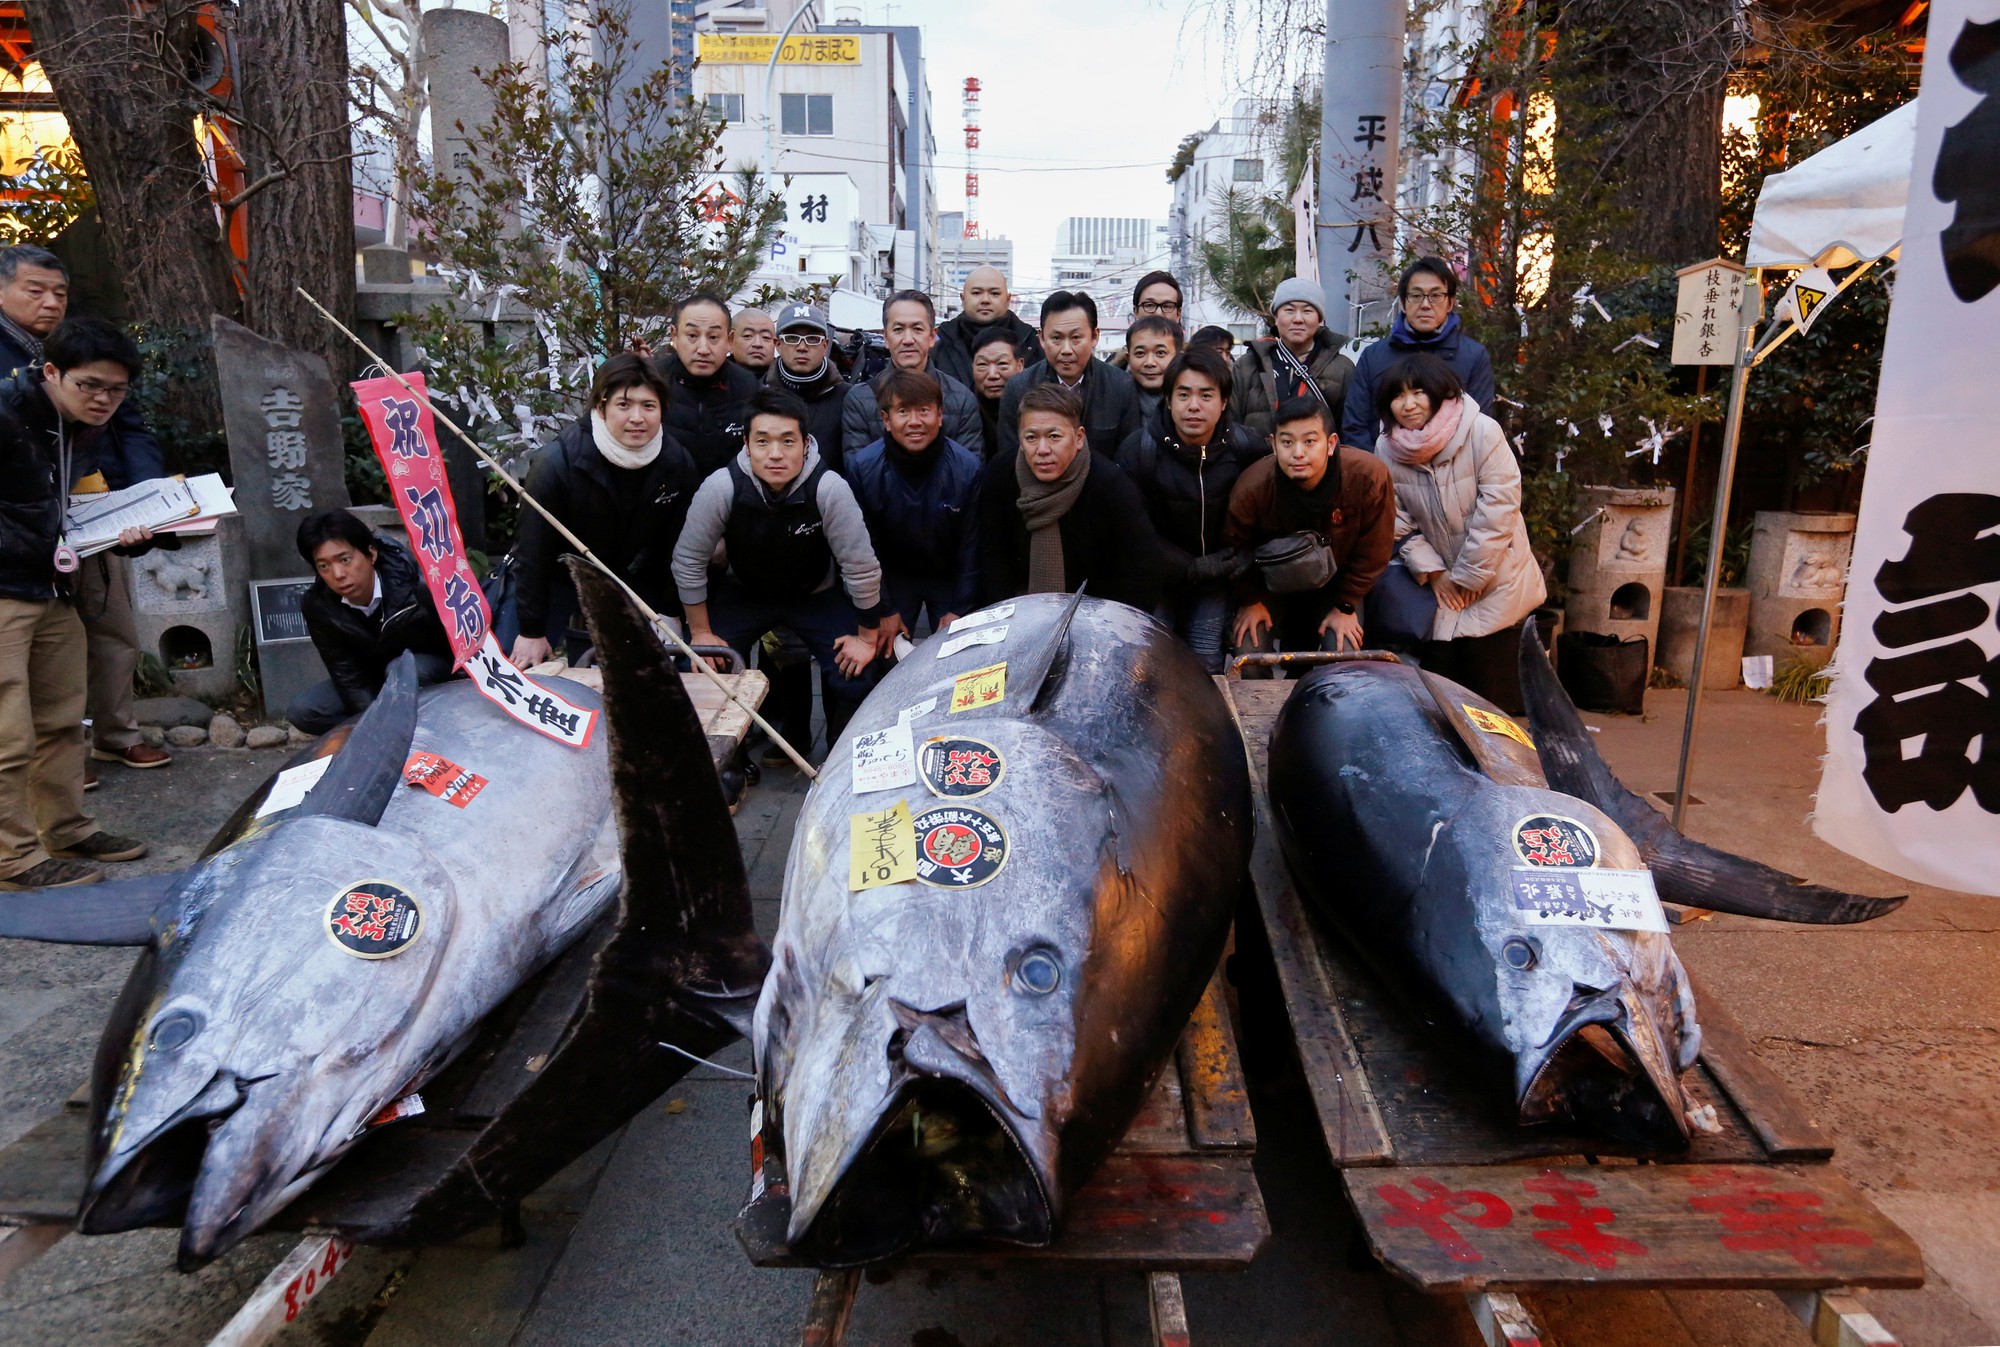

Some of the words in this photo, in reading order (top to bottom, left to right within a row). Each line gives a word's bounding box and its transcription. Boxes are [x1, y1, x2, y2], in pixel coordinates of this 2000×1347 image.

[782, 38, 856, 61] のかまぼこ
[1347, 115, 1386, 252] 平成八
[770, 242, 787, 261] P
[794, 305, 810, 318] M
[1728, 274, 1741, 310] 御神木
[1698, 269, 1721, 357] 枝垂れ銀杏
[260, 387, 313, 510] 吉野家
[380, 396, 488, 649] 祝初荷
[466, 648, 580, 736] 水産
[945, 750, 966, 785] まぐろ
[966, 750, 999, 786] 大間
[1519, 828, 1554, 866] 大間
[1549, 825, 1575, 866] まぐろ
[1519, 882, 1563, 900] 最北
[331, 892, 375, 936] 大間
[358, 894, 397, 941] まぐろ
[1375, 1167, 1873, 1274] やま幸
